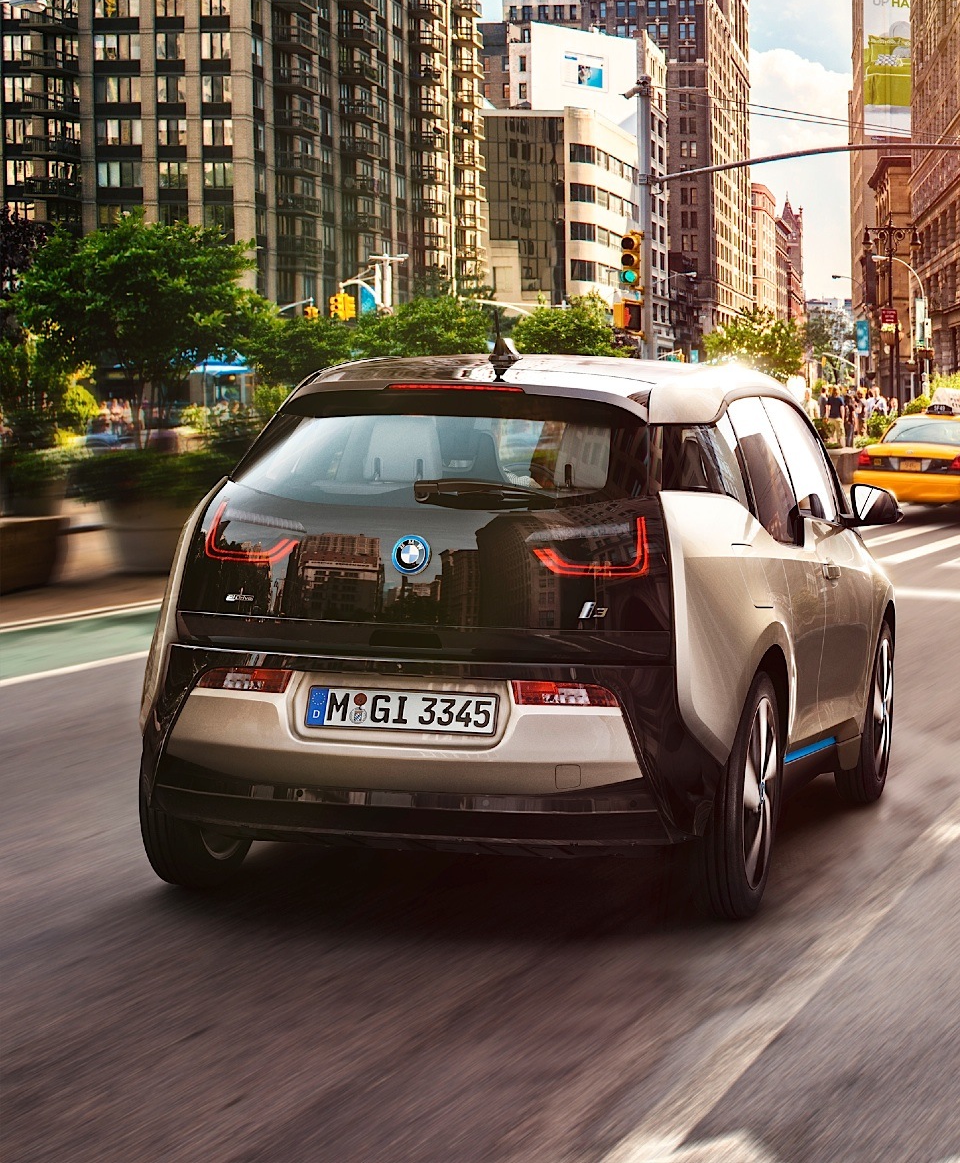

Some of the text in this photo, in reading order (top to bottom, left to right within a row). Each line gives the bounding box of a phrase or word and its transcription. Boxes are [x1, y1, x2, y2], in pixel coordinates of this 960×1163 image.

[578, 601, 609, 619] i3
[312, 709, 320, 719] D
[326, 692, 492, 729] M GI 3345
